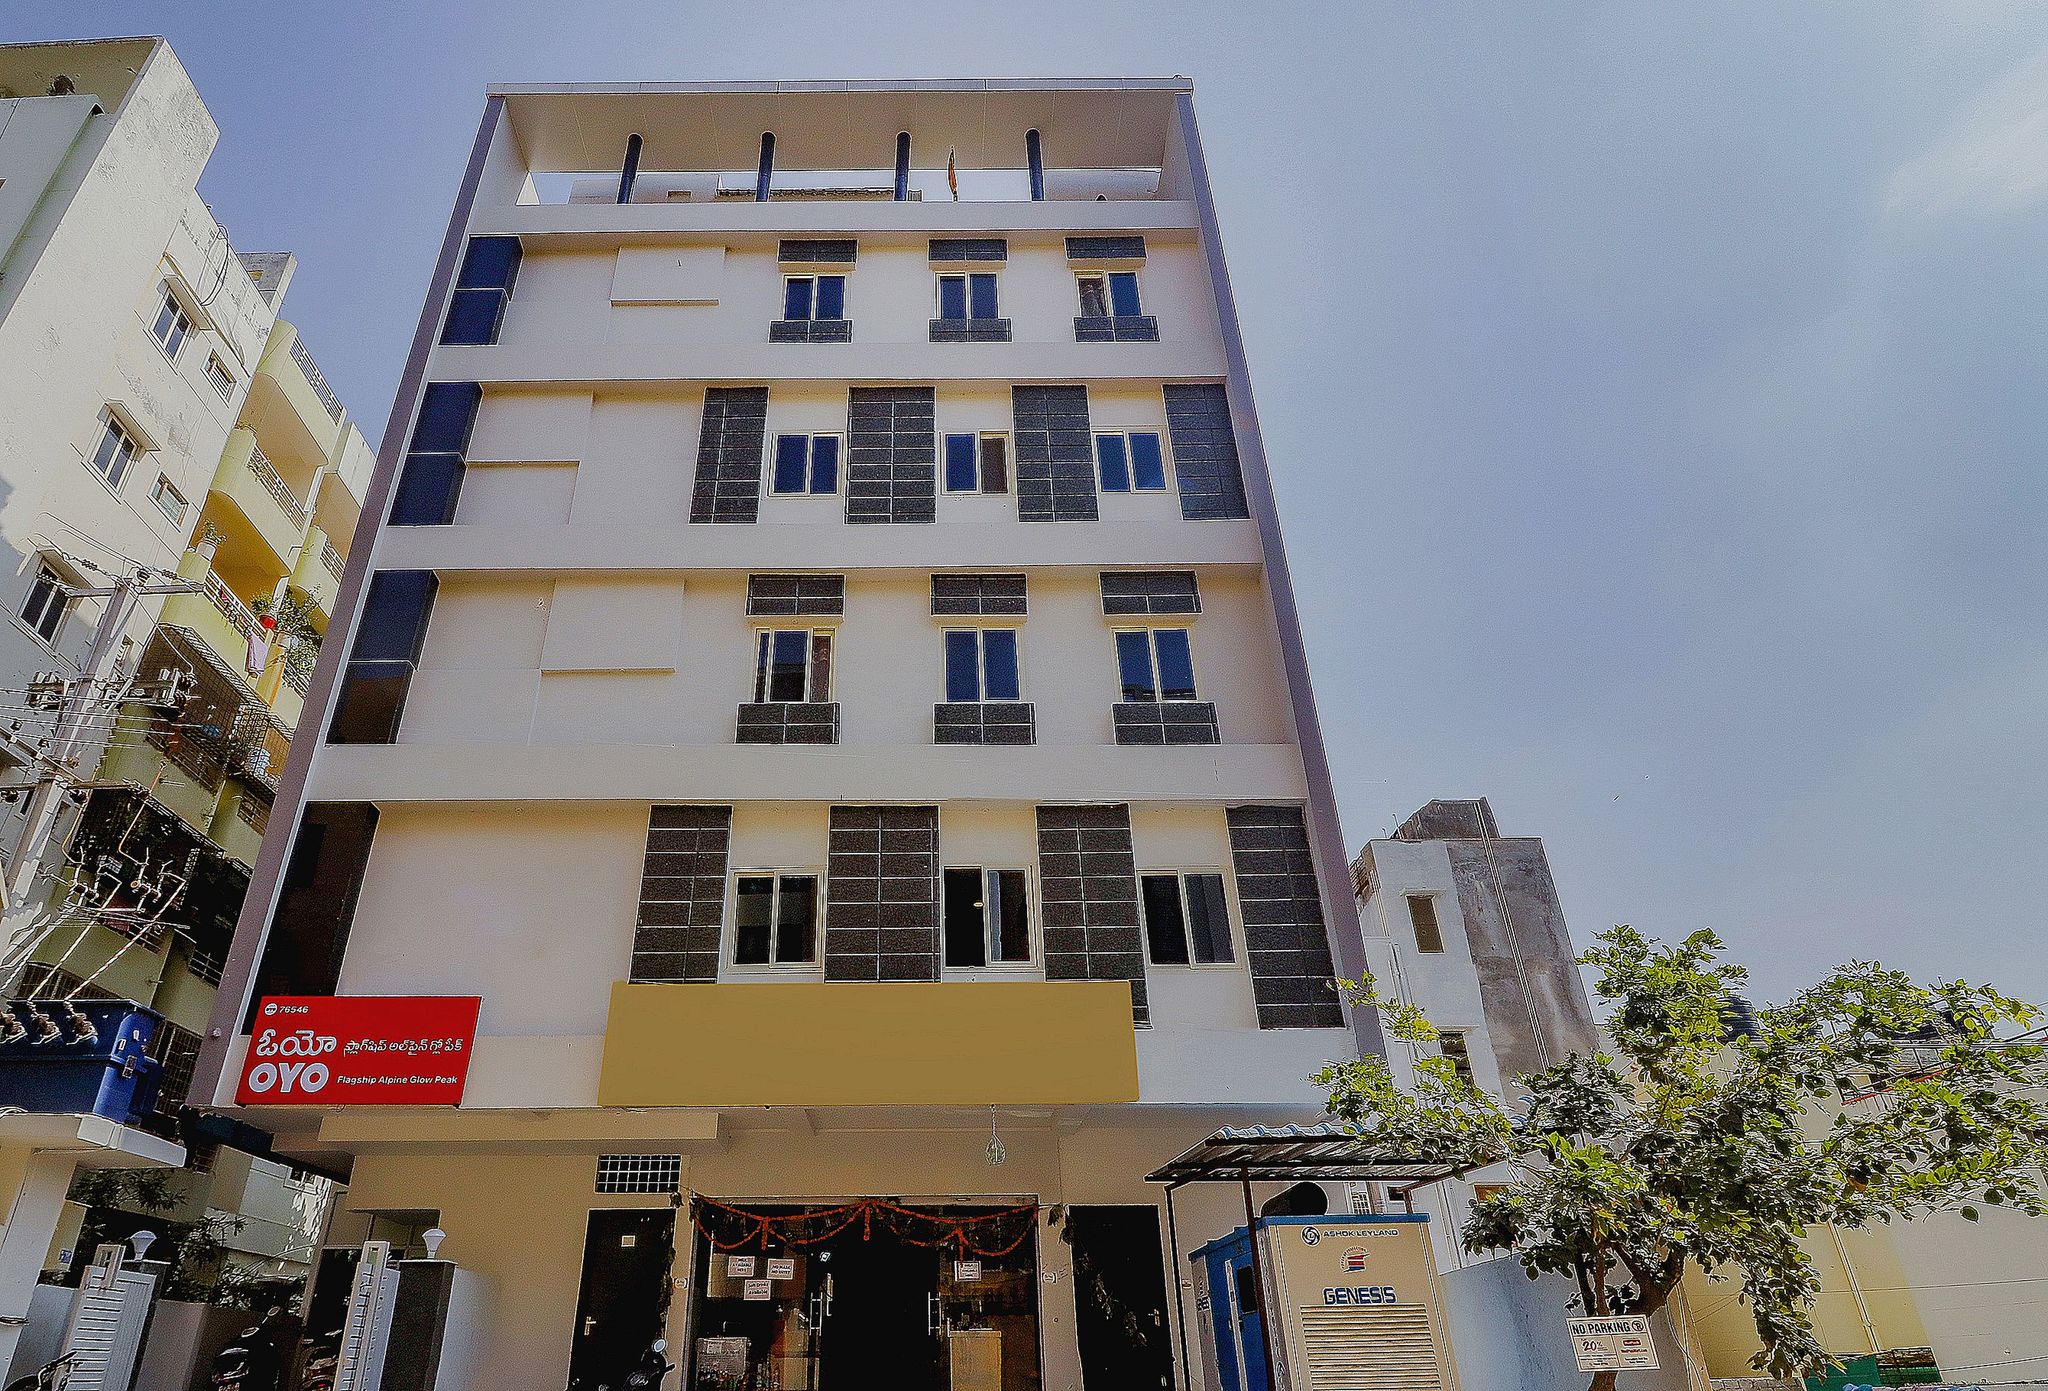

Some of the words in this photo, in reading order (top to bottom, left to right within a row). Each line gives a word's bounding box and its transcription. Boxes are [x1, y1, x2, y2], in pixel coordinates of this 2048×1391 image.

[279, 1005, 309, 1014] 76546
[256, 1028, 337, 1056] ఓయో
[249, 1063, 329, 1093] OYO
[337, 1075, 376, 1086] Flagship
[377, 1075, 408, 1085] Alpine
[409, 1075, 433, 1084] Glow
[434, 1075, 458, 1084] Peak
[1323, 1229, 1355, 1237] ASHOK
[1356, 1228, 1399, 1237] LEYLAND
[1323, 1286, 1396, 1305] GENESIS
[1572, 1323, 1586, 1335] NO
[1587, 1321, 1631, 1334] PARKING
